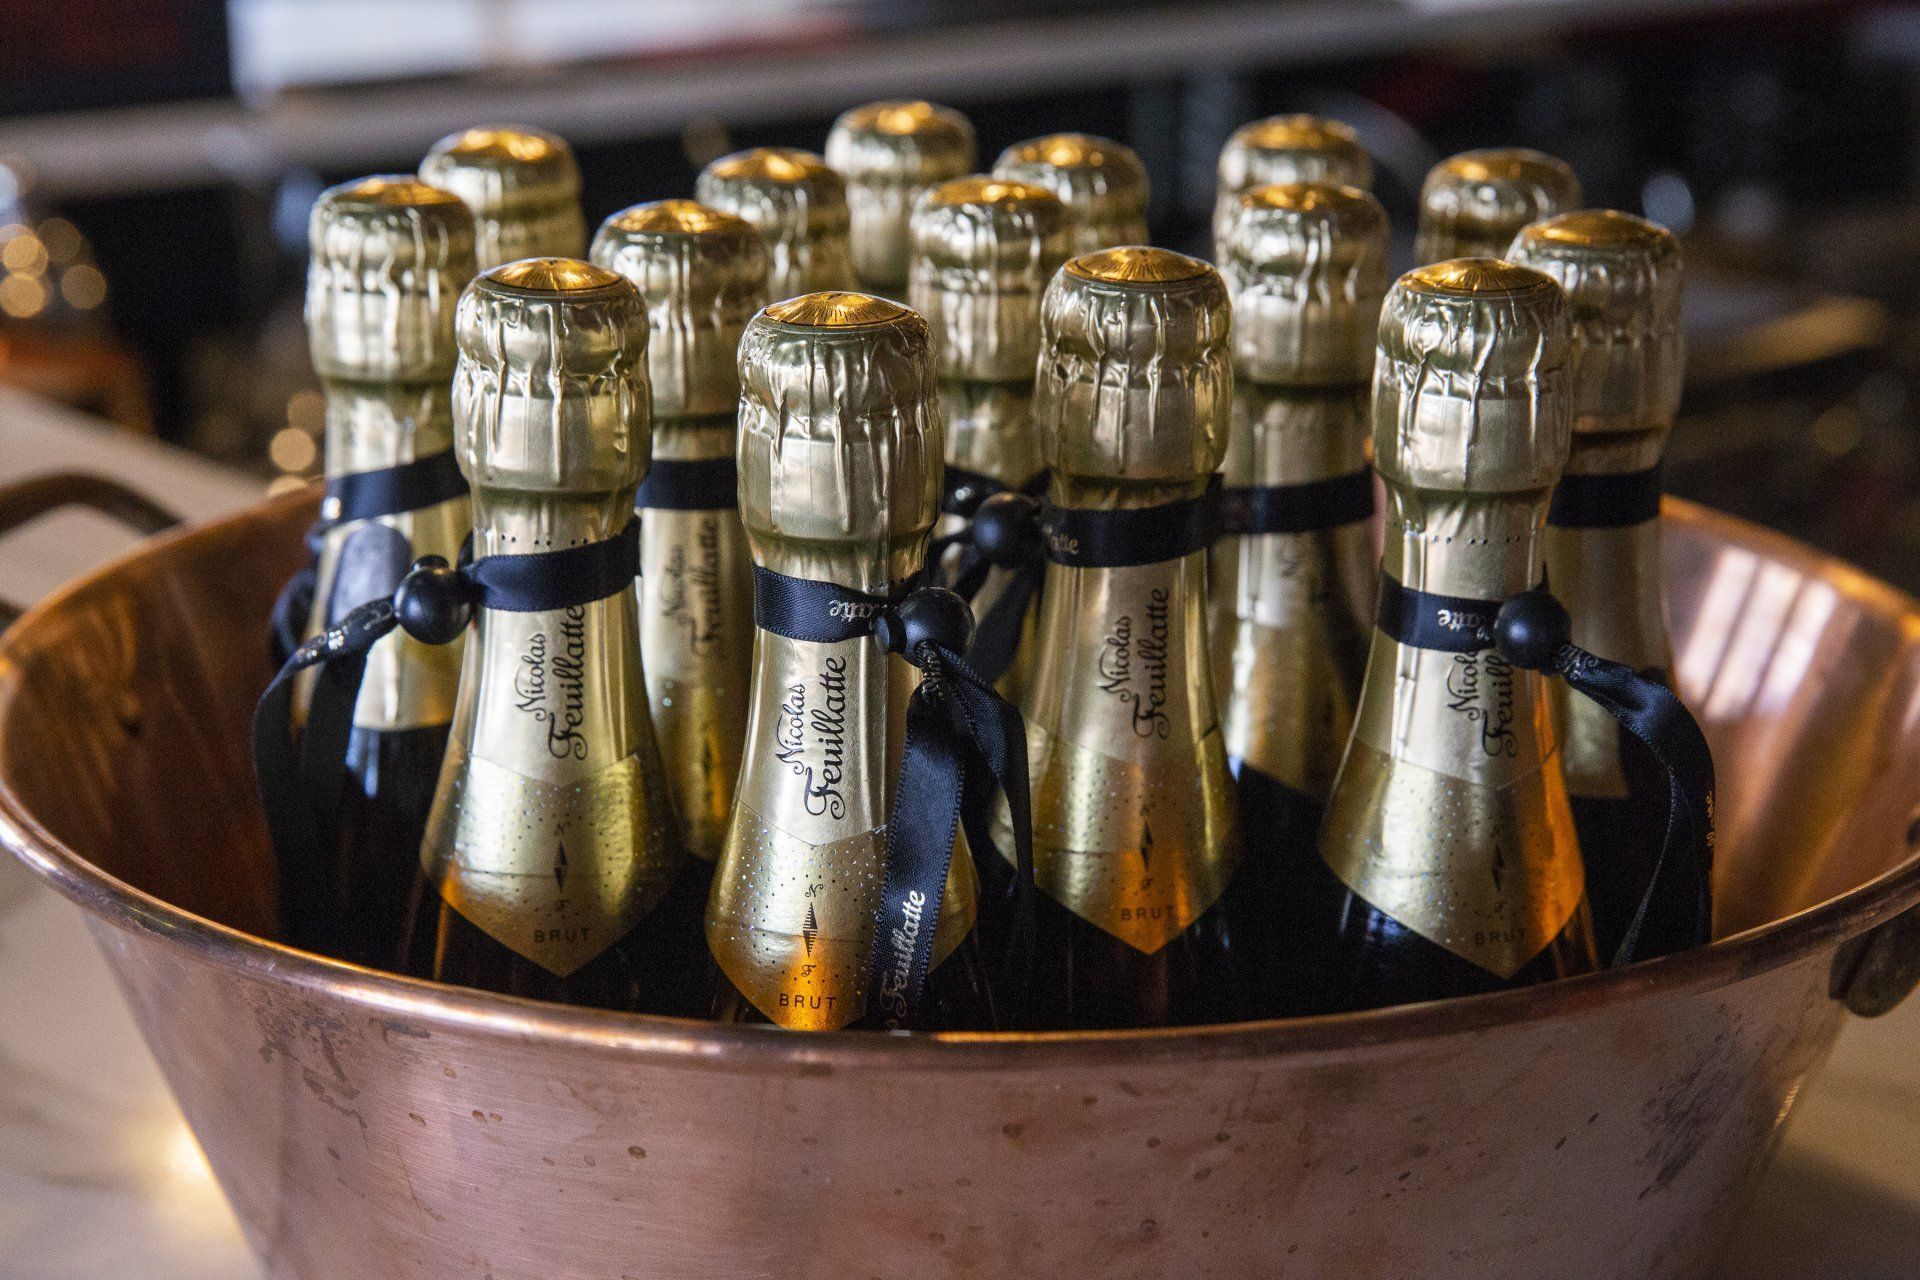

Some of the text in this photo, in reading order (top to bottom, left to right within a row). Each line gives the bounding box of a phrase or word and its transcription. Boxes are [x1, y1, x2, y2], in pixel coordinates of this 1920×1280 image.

[514, 632, 547, 722] Nicolas
[547, 604, 588, 761] Feuillatte
[1099, 615, 1132, 703] Nicolas
[1132, 588, 1170, 740] Feuillatte
[1447, 651, 1481, 721] Nicol
[775, 682, 806, 775] Nicolas
[803, 655, 847, 820] Feuillatte
[804, 883, 824, 898] N
[1120, 904, 1175, 921] BRUT
[533, 927, 591, 944] BRUT
[778, 993, 837, 1011] BRUT
